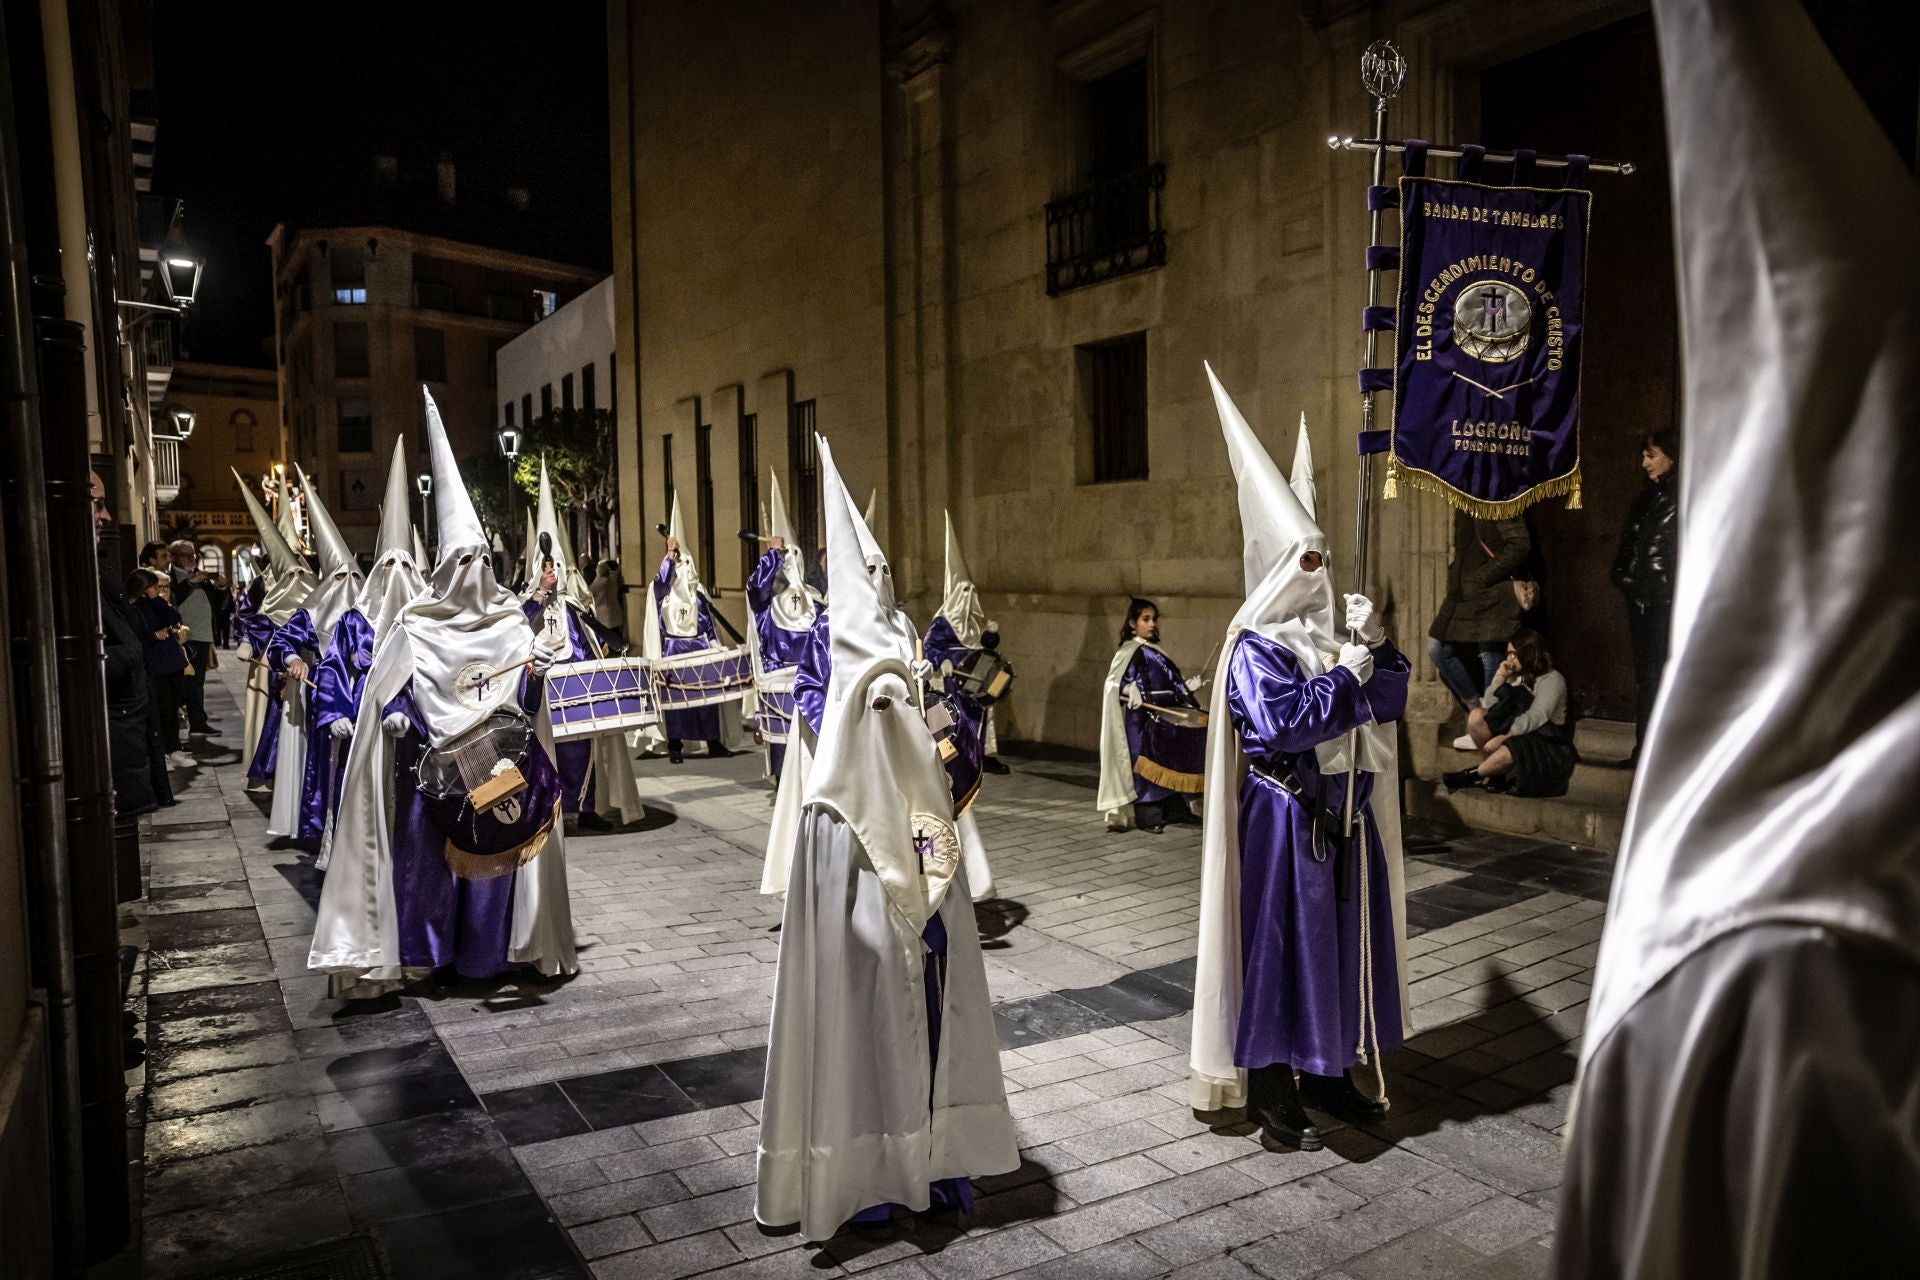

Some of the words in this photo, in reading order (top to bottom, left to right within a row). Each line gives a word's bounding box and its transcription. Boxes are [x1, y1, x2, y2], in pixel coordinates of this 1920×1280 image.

[1423, 202, 1469, 220] BANDA
[1472, 207, 1489, 223] DE
[1492, 210, 1564, 230] TAMBORES
[1416, 254, 1535, 337] DESCENDIMIENTO
[1534, 279, 1554, 304] DE
[1416, 339, 1433, 361] EL
[1546, 306, 1564, 371] CRISTO
[1452, 420, 1531, 442] LOGROÑO
[1454, 440, 1504, 453] FUNDADA
[1506, 444, 1529, 456] 2001
